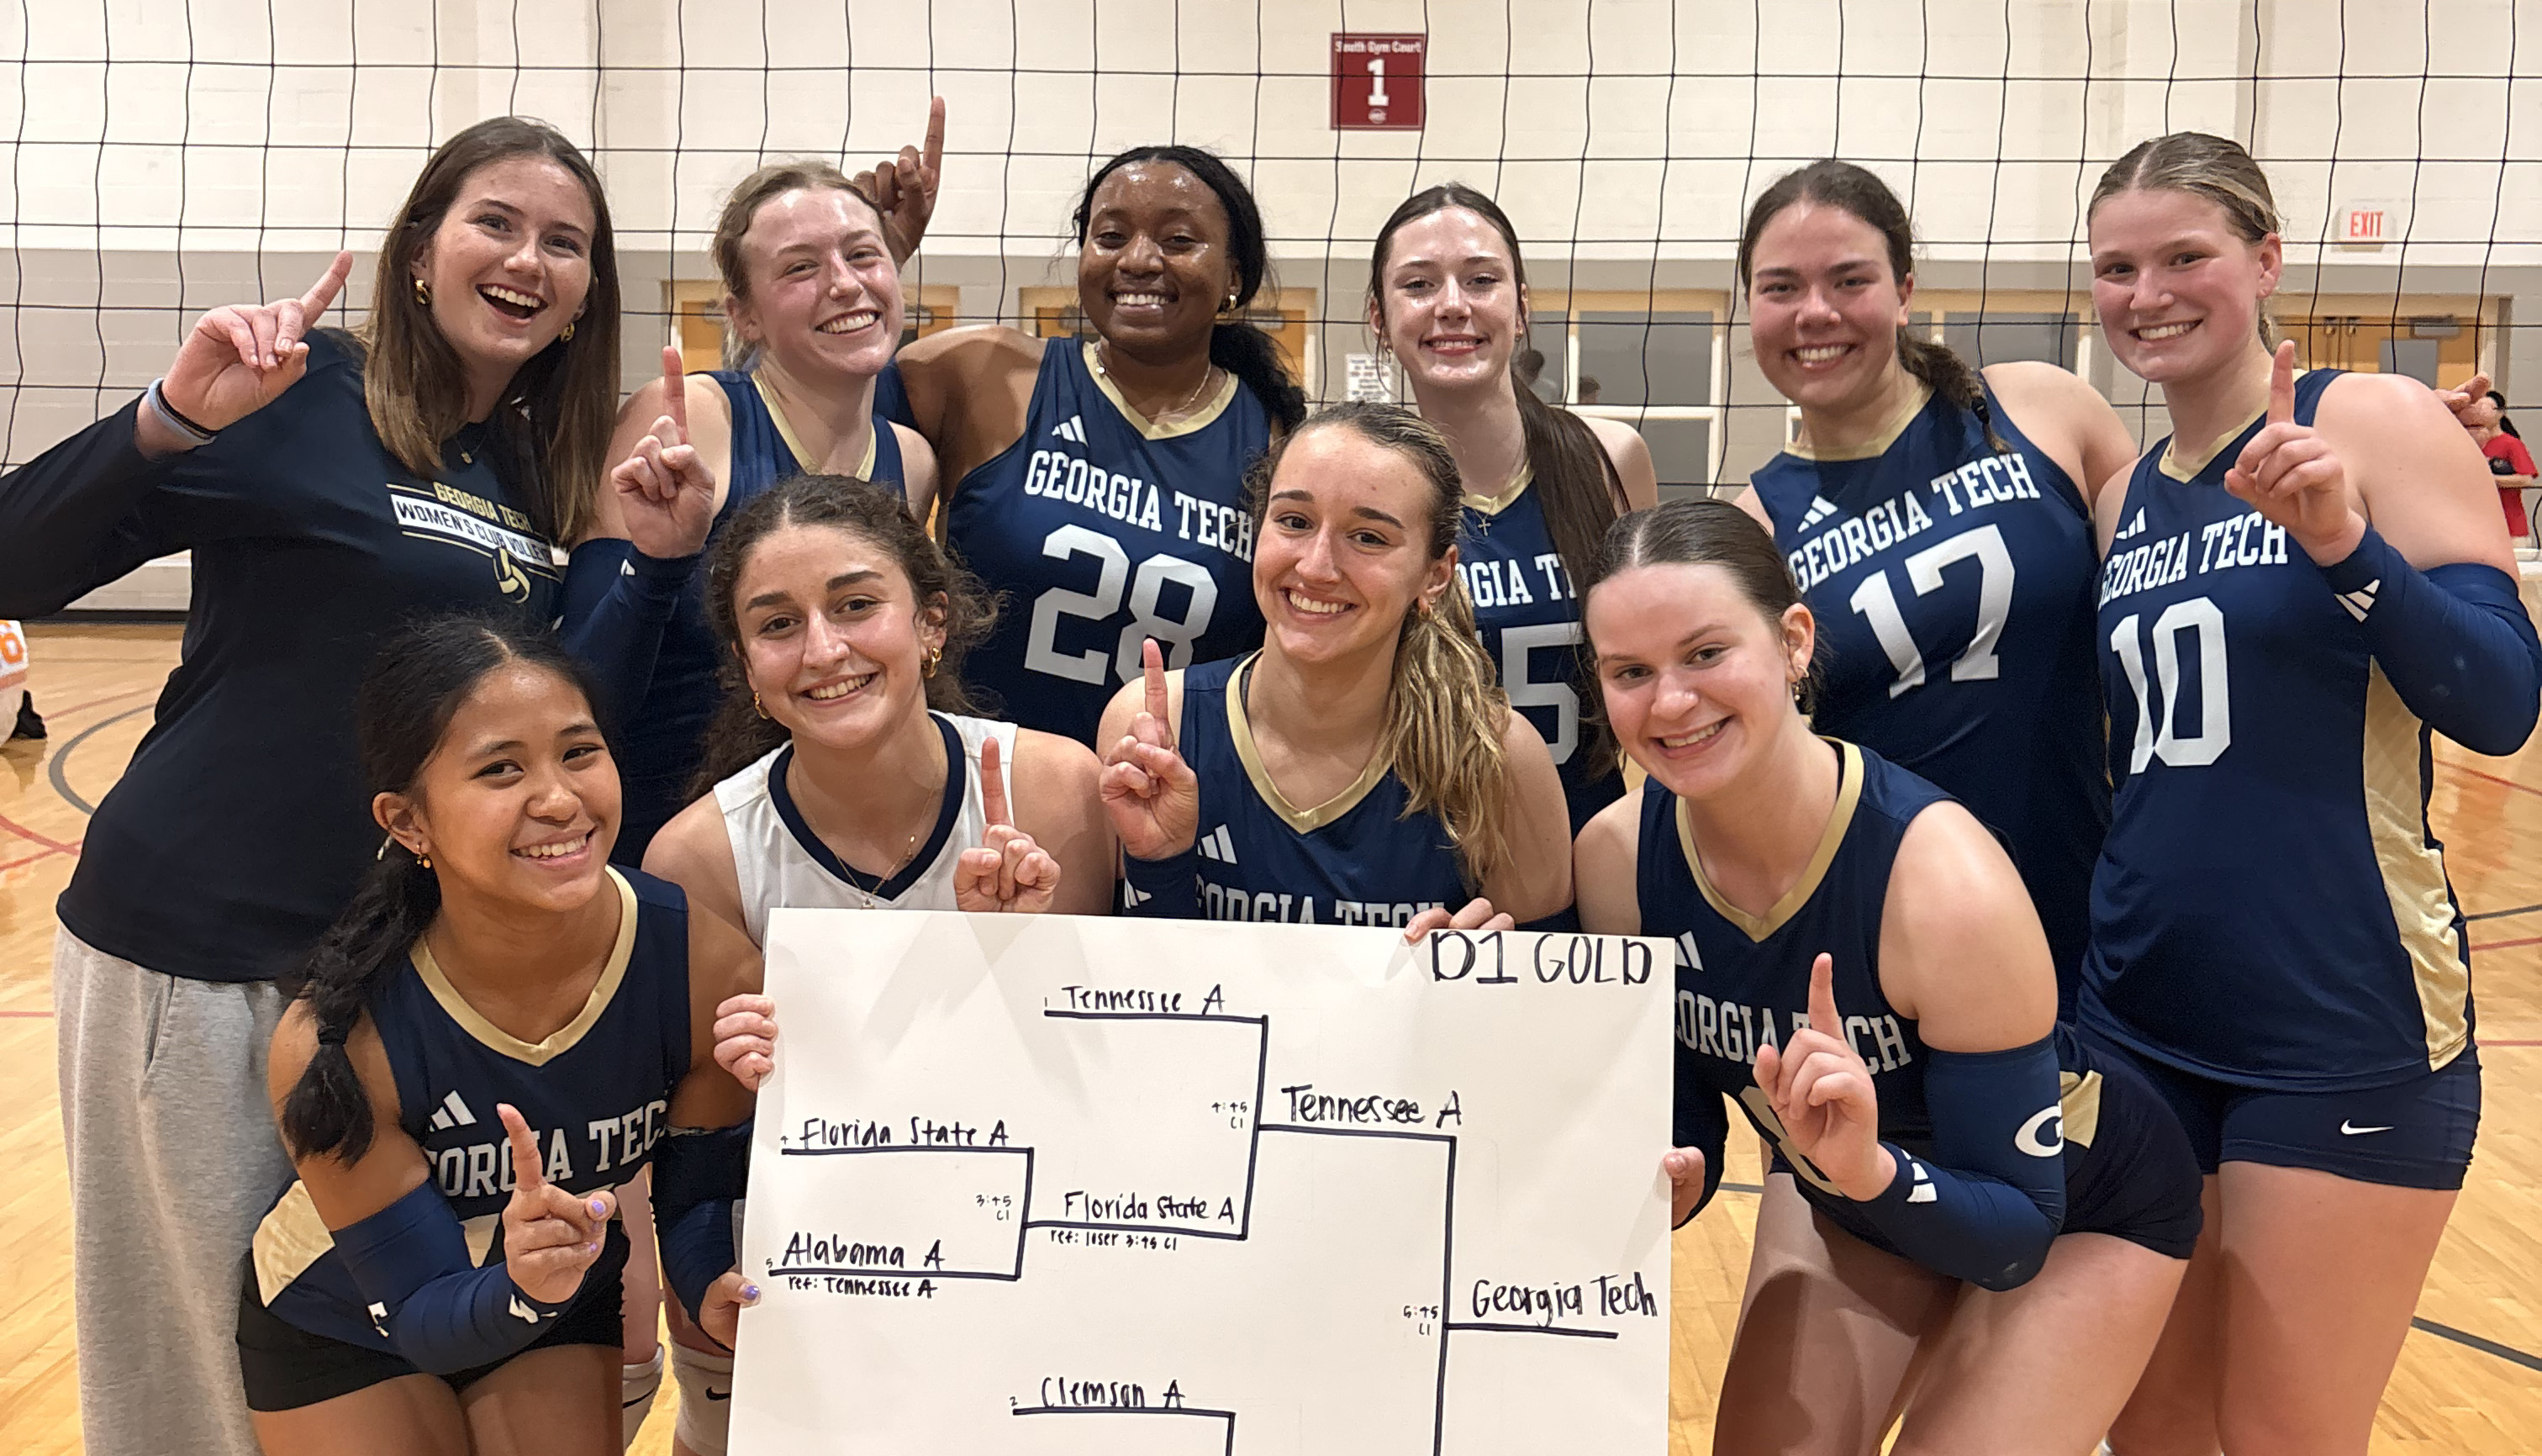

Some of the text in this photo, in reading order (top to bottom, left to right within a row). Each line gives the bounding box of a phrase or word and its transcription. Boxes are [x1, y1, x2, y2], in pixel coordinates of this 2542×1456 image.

[1367, 58, 1389, 106] 1
[2350, 210, 2384, 237] EXIT
[395, 500, 475, 536] WOMEN'S
[474, 523, 506, 548] CLUB
[433, 481, 534, 534] GEORGIA TECH
[1025, 450, 1254, 563] GEORGIA TECH
[1787, 453, 2040, 594] GEORGIA TECH
[2198, 510, 2288, 574] TECH
[1024, 523, 1218, 686] 28
[1849, 523, 2015, 699] 17
[2110, 596, 2231, 774] 10
[1431, 930, 1653, 985] D1 GOLD
[1061, 985, 1182, 1012] Tennessee
[1201, 984, 1226, 1016] A
[1280, 1084, 1462, 1129] Tennessee A
[799, 1118, 891, 1149] Florida
[910, 1116, 977, 1147] State
[989, 1120, 1009, 1147] A
[1064, 1190, 1235, 1225] Florida State A
[782, 1232, 904, 1269] Alabama
[924, 1239, 946, 1271] A
[824, 1277, 910, 1297] Tennessee
[917, 1279, 938, 1299] A
[1472, 1271, 1659, 1327] Georgia Tech
[1042, 1376, 1145, 1408] Clemson
[1163, 1379, 1185, 1409] A
